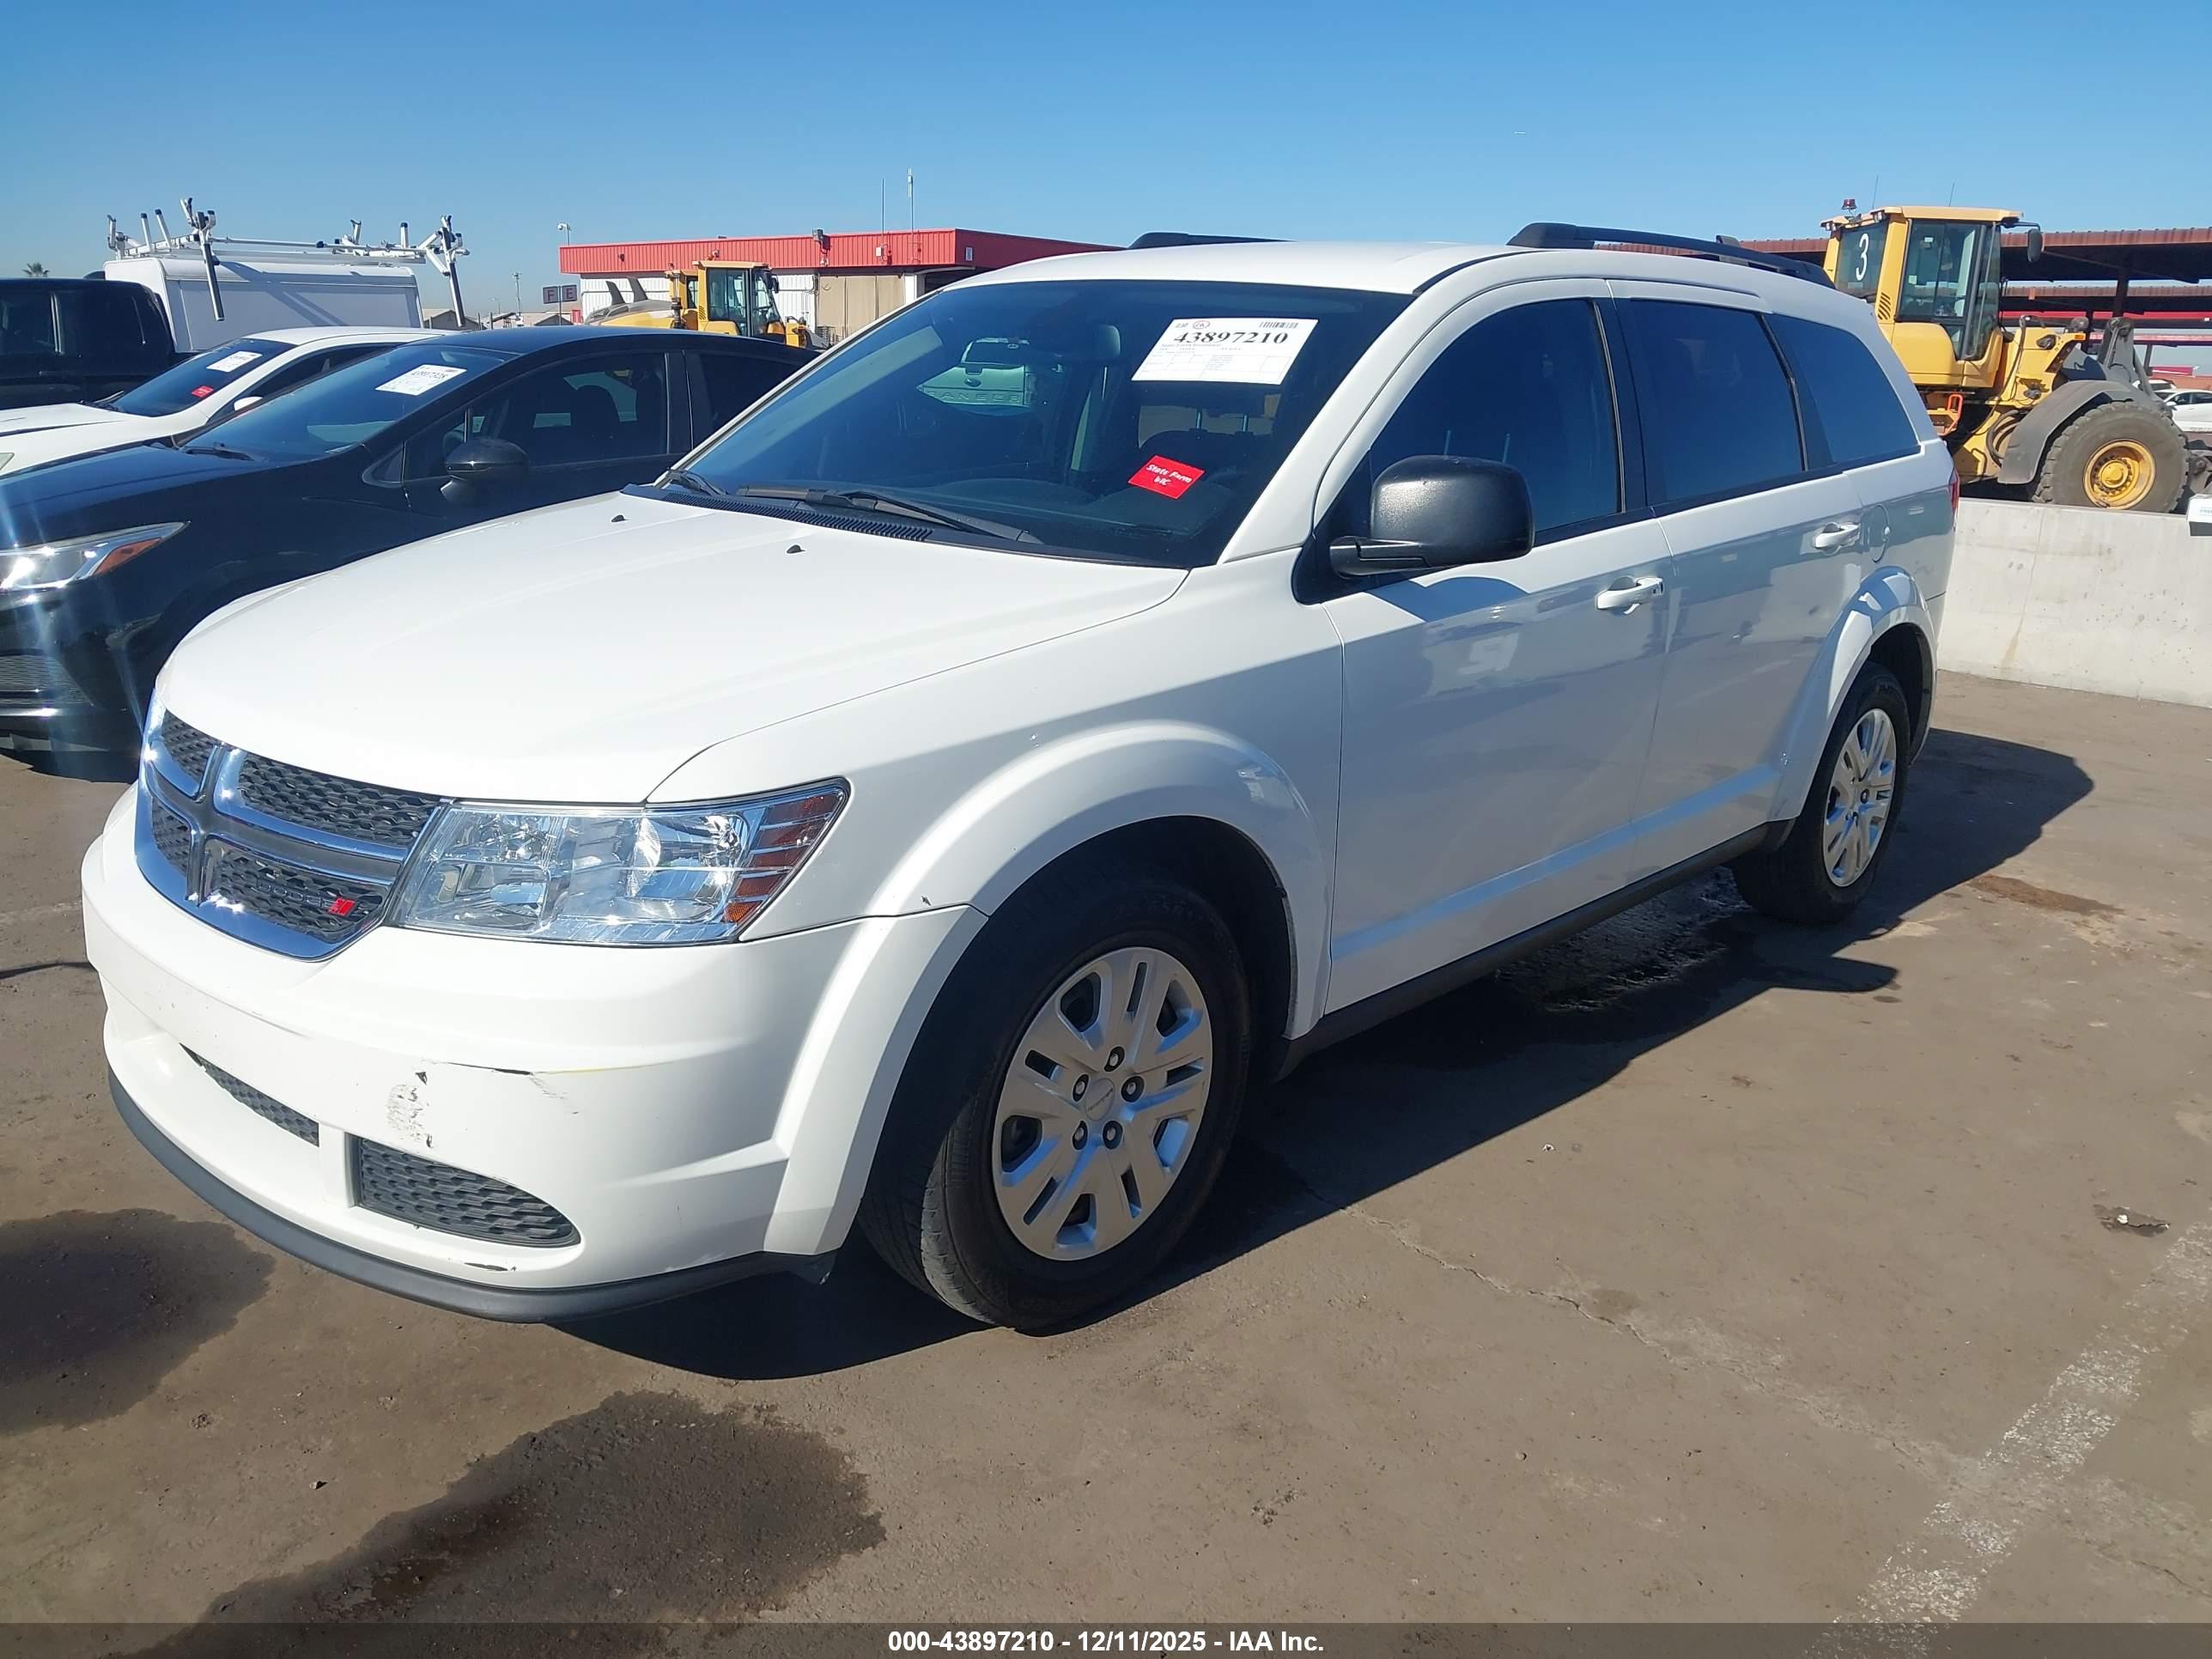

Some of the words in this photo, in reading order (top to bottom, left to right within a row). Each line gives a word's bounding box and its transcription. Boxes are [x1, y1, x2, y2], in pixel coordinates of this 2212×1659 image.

[1856, 233, 1869, 281] 3
[547, 289, 555, 302] F
[566, 288, 574, 300] E
[1173, 331, 1289, 344] 43897210
